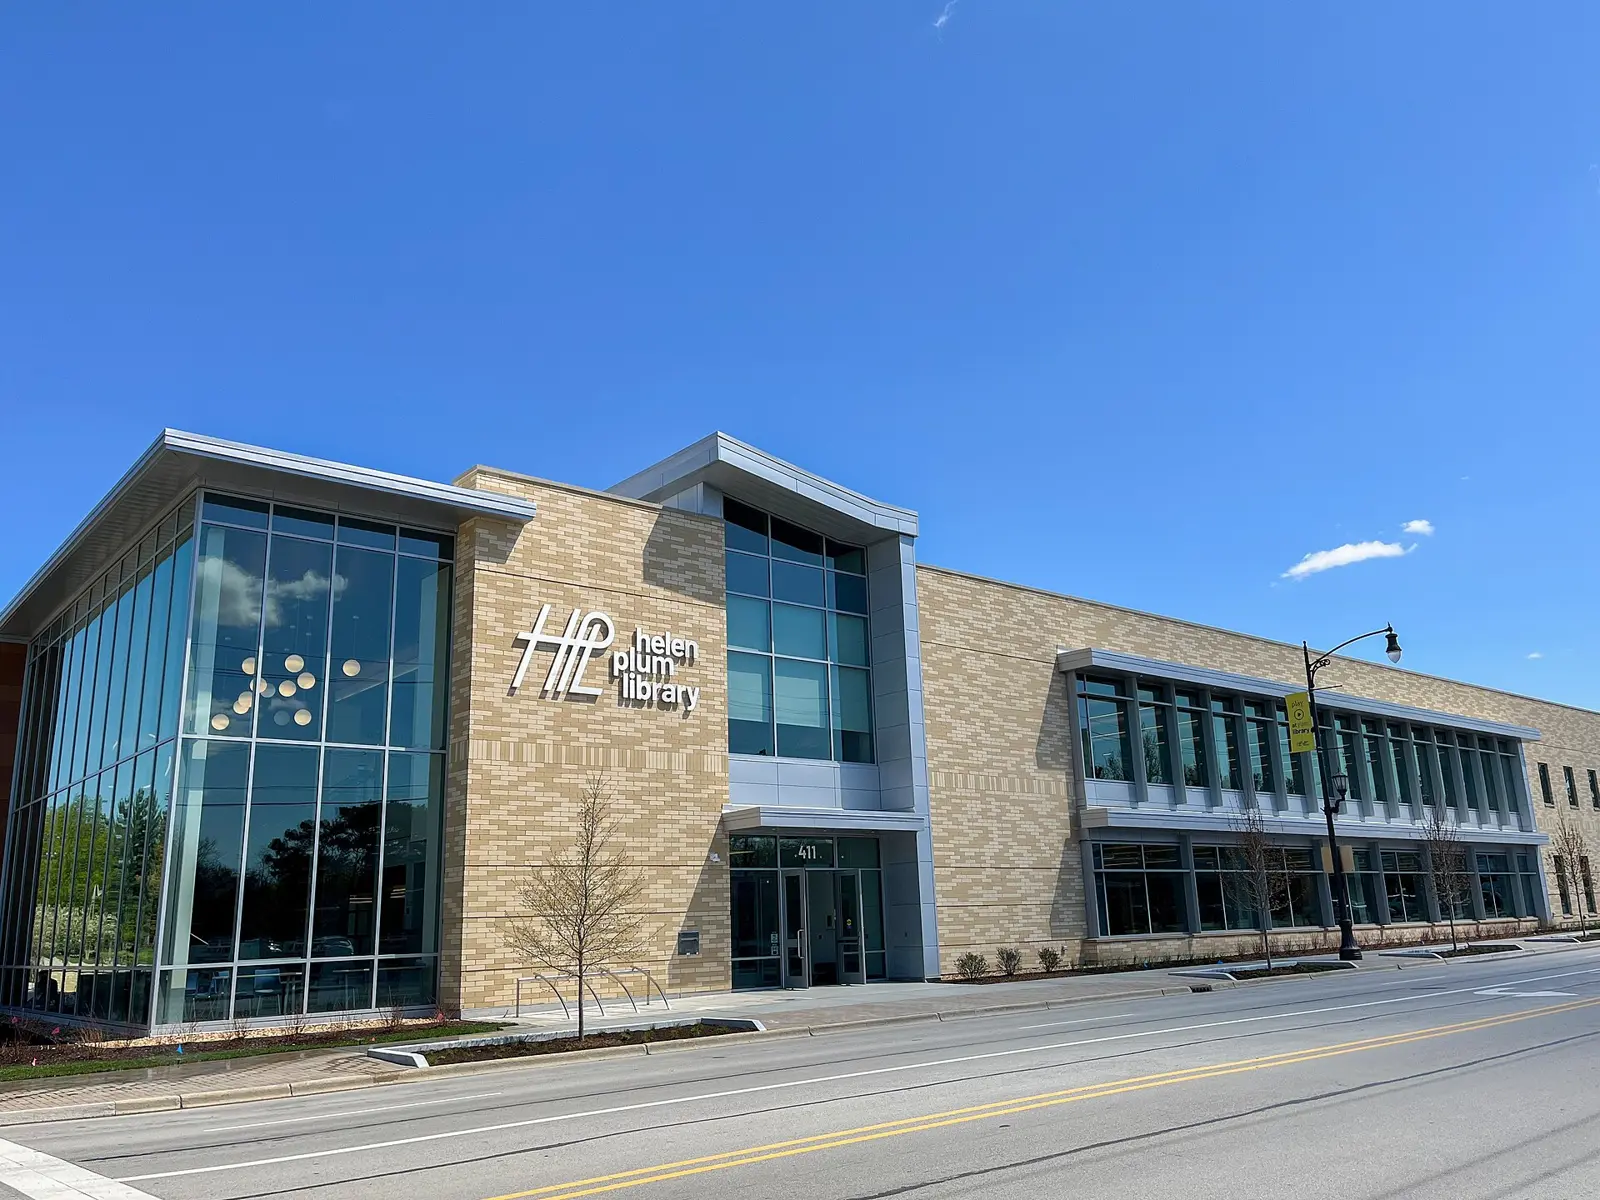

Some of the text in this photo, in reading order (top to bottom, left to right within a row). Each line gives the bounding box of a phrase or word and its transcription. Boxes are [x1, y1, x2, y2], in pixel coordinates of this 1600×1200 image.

[636, 627, 699, 659] helen
[613, 647, 674, 676] plum
[622, 672, 700, 710] library
[798, 845, 816, 859] 411
